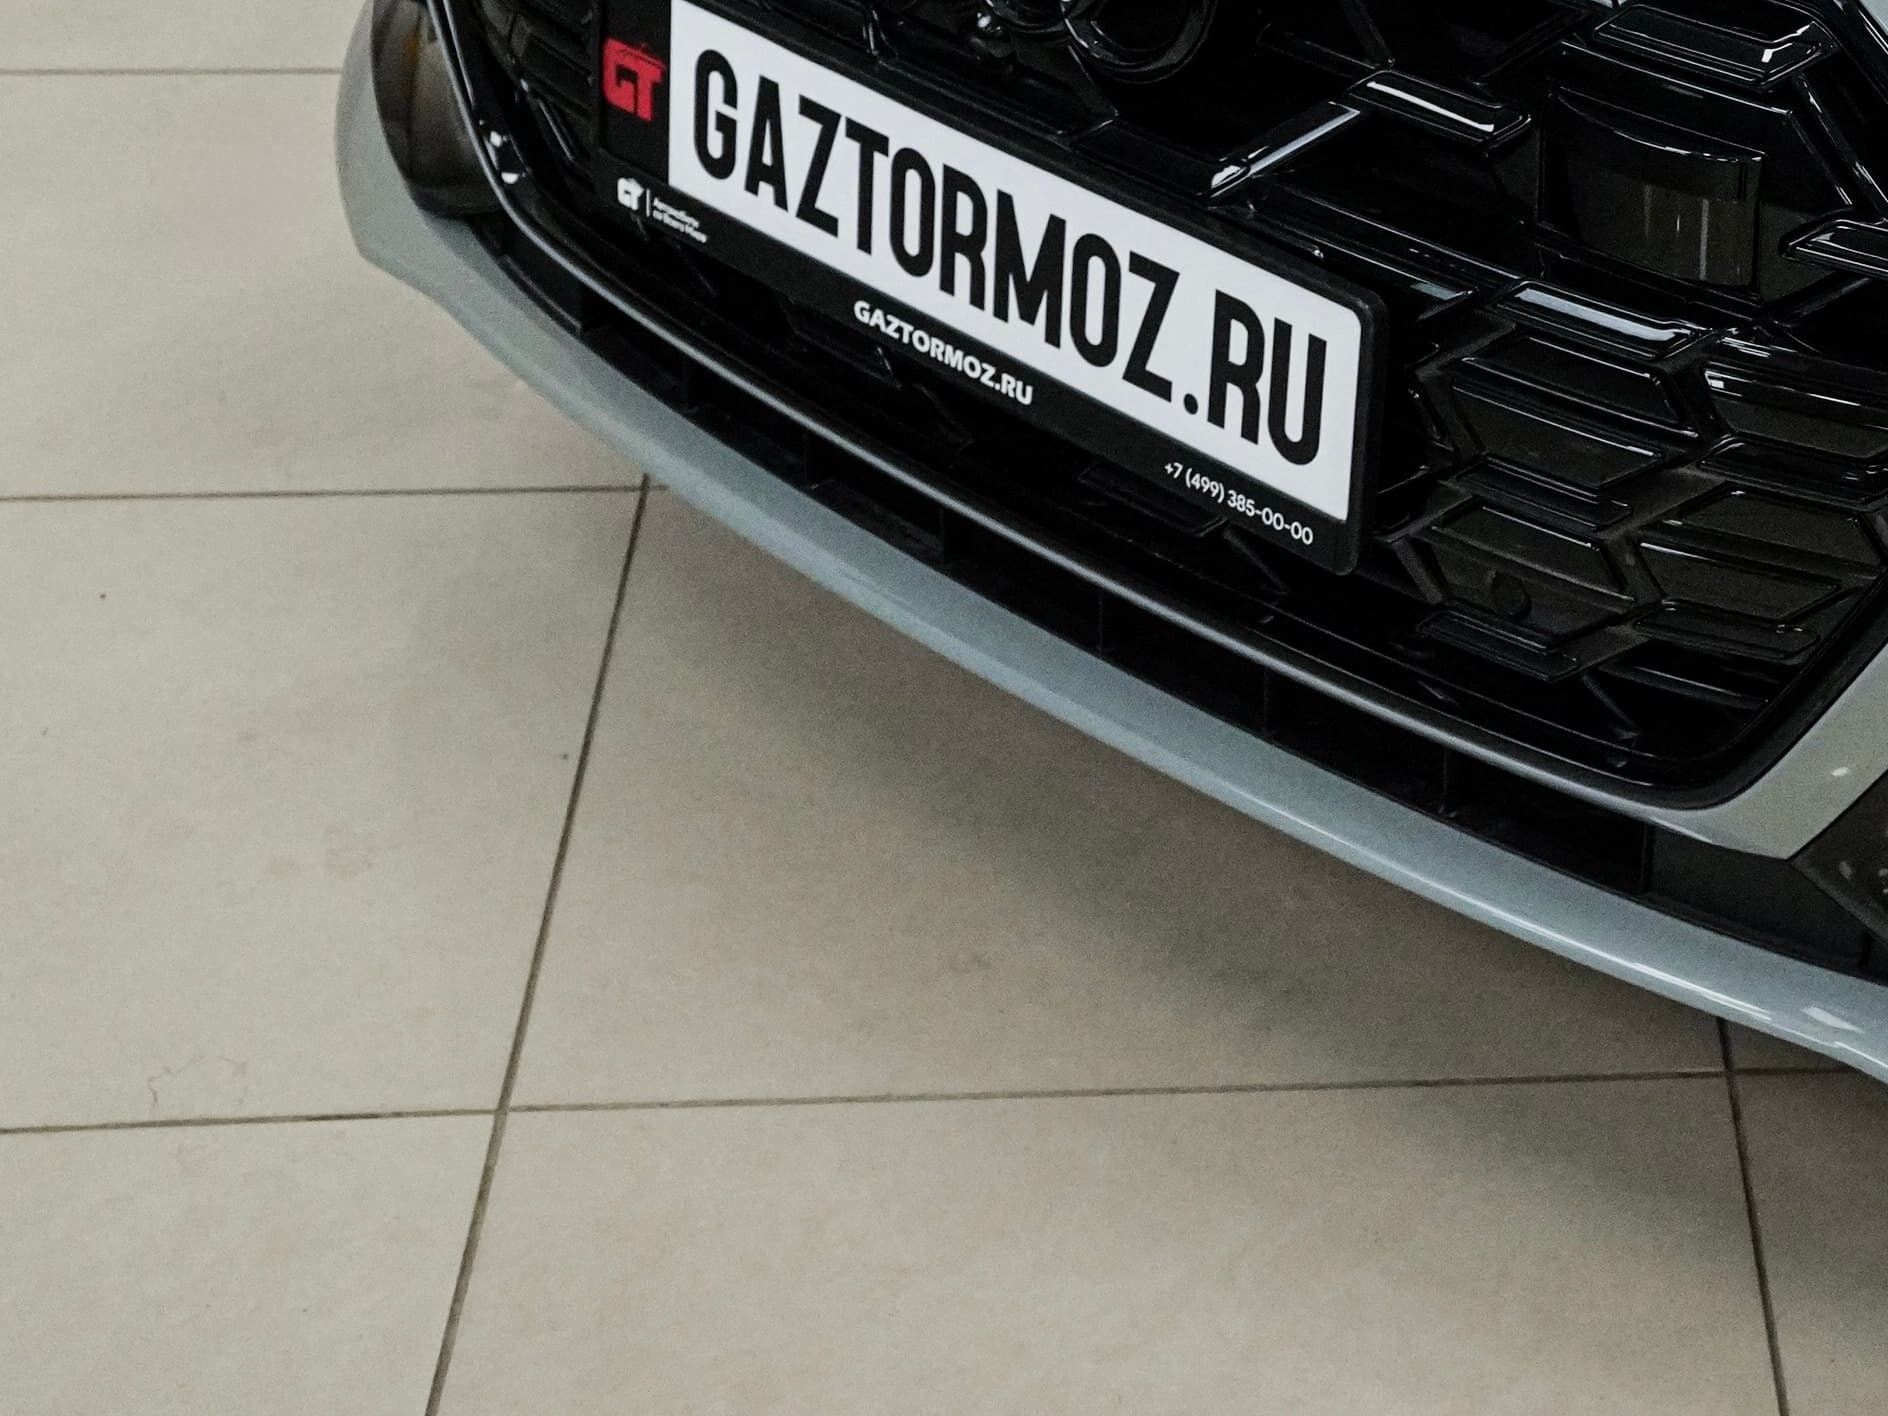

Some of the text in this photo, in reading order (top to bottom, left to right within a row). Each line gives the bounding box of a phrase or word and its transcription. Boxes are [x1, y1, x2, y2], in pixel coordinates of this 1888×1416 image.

[694, 49, 1327, 466] GAZTORMOZ.RU
[853, 300, 1033, 406] GAZTORMOZ.RU
[1164, 462, 1314, 545] +7 (499) 385-00-00
